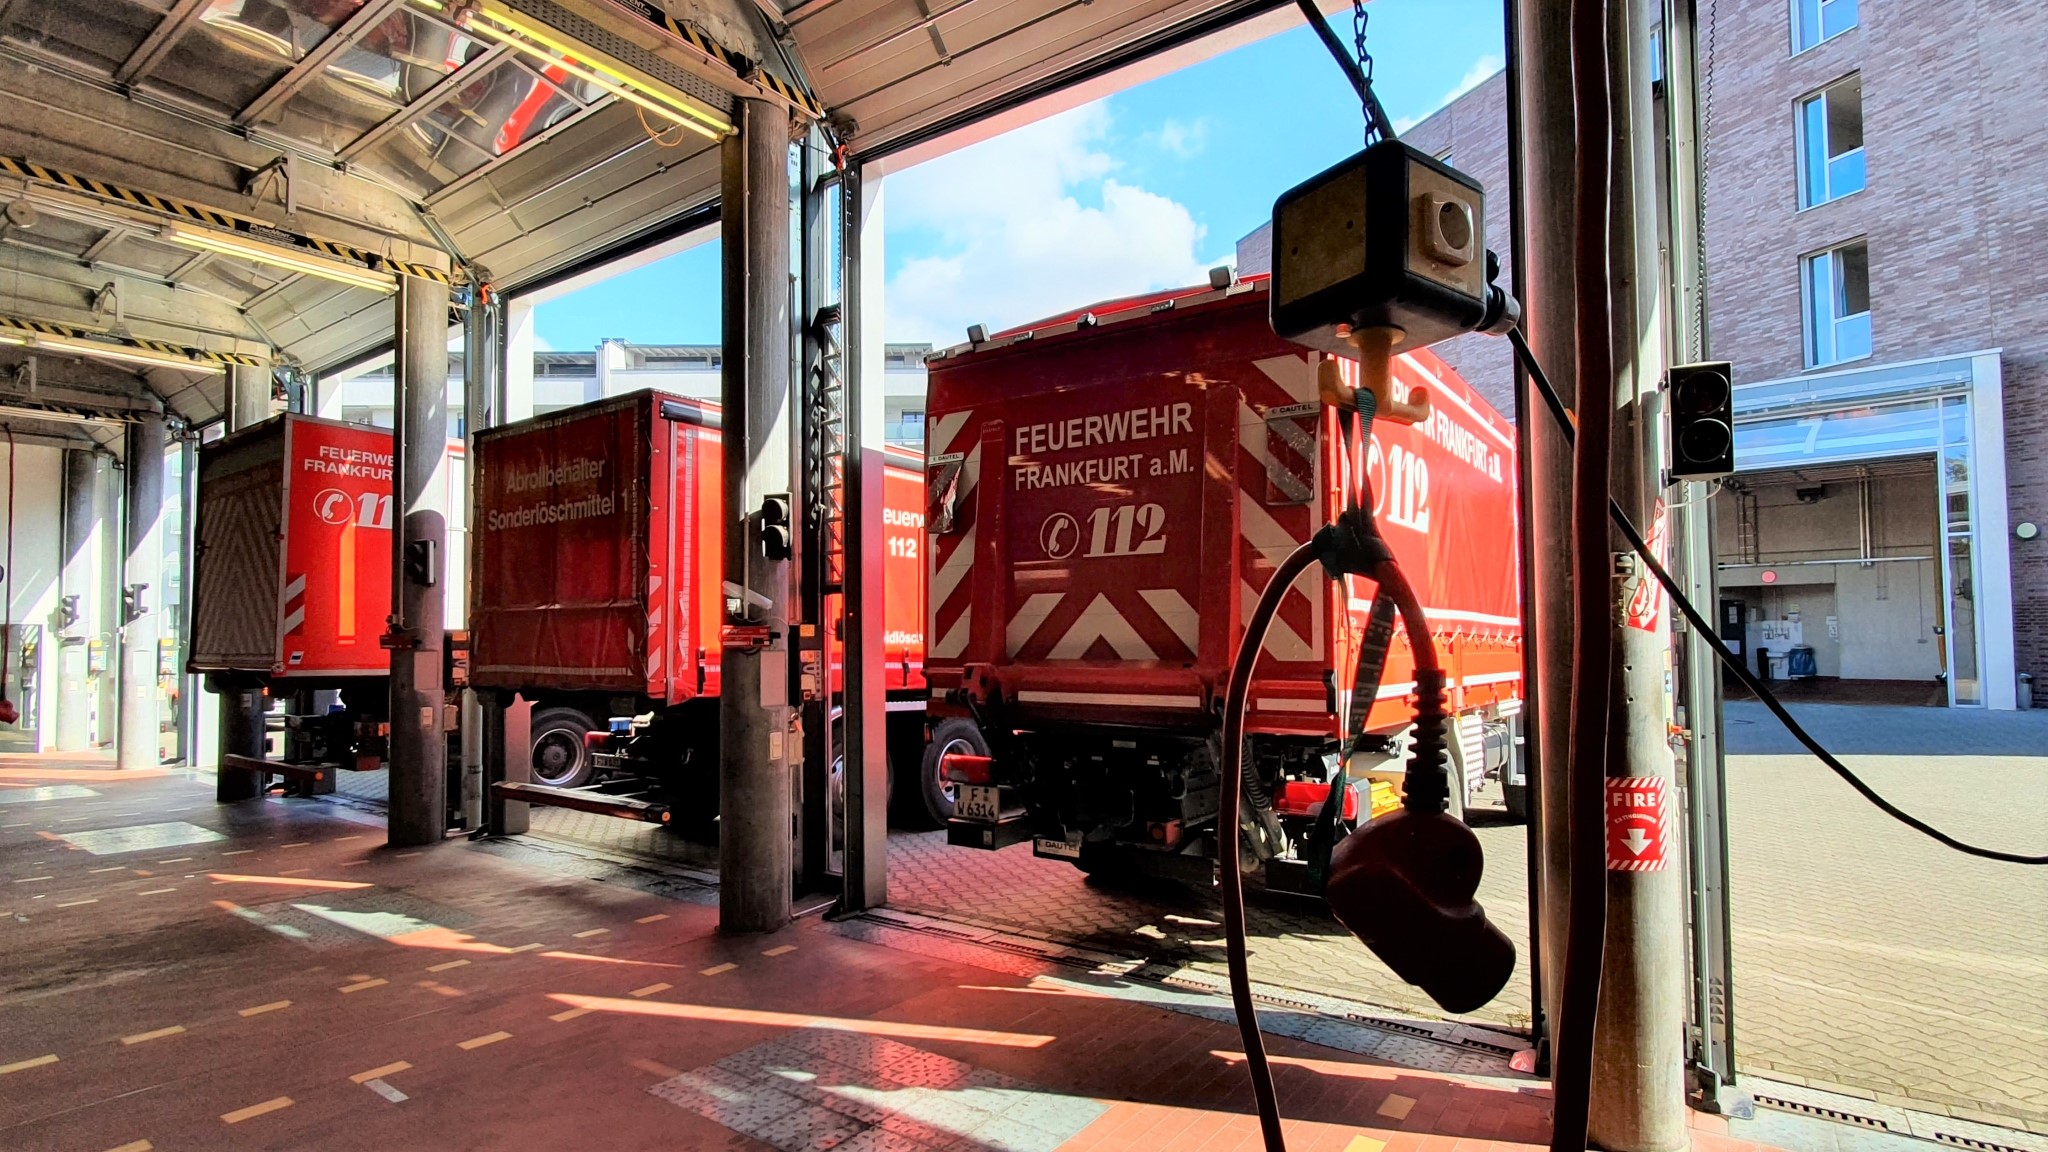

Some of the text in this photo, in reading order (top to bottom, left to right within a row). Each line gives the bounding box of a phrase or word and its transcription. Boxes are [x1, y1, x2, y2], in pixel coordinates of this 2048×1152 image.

[1015, 402, 1193, 456] FEUERWEHR
[1437, 408, 1487, 474] FRANKFURT
[1796, 417, 1823, 454] 7
[304, 458, 393, 480] FRANKFUR
[320, 445, 394, 467] FEUERWE
[1015, 448, 1194, 491] FRANKFURT a.M.
[506, 457, 606, 494] Abrollbehälter
[1386, 443, 1430, 534] 112
[488, 488, 628, 532] Sonderlöschmittel 1
[888, 536, 917, 558] 112
[1083, 503, 1167, 558] 112
[967, 802, 995, 818] 6314
[971, 787, 979, 801] F
[1612, 792, 1657, 807] FIRE
